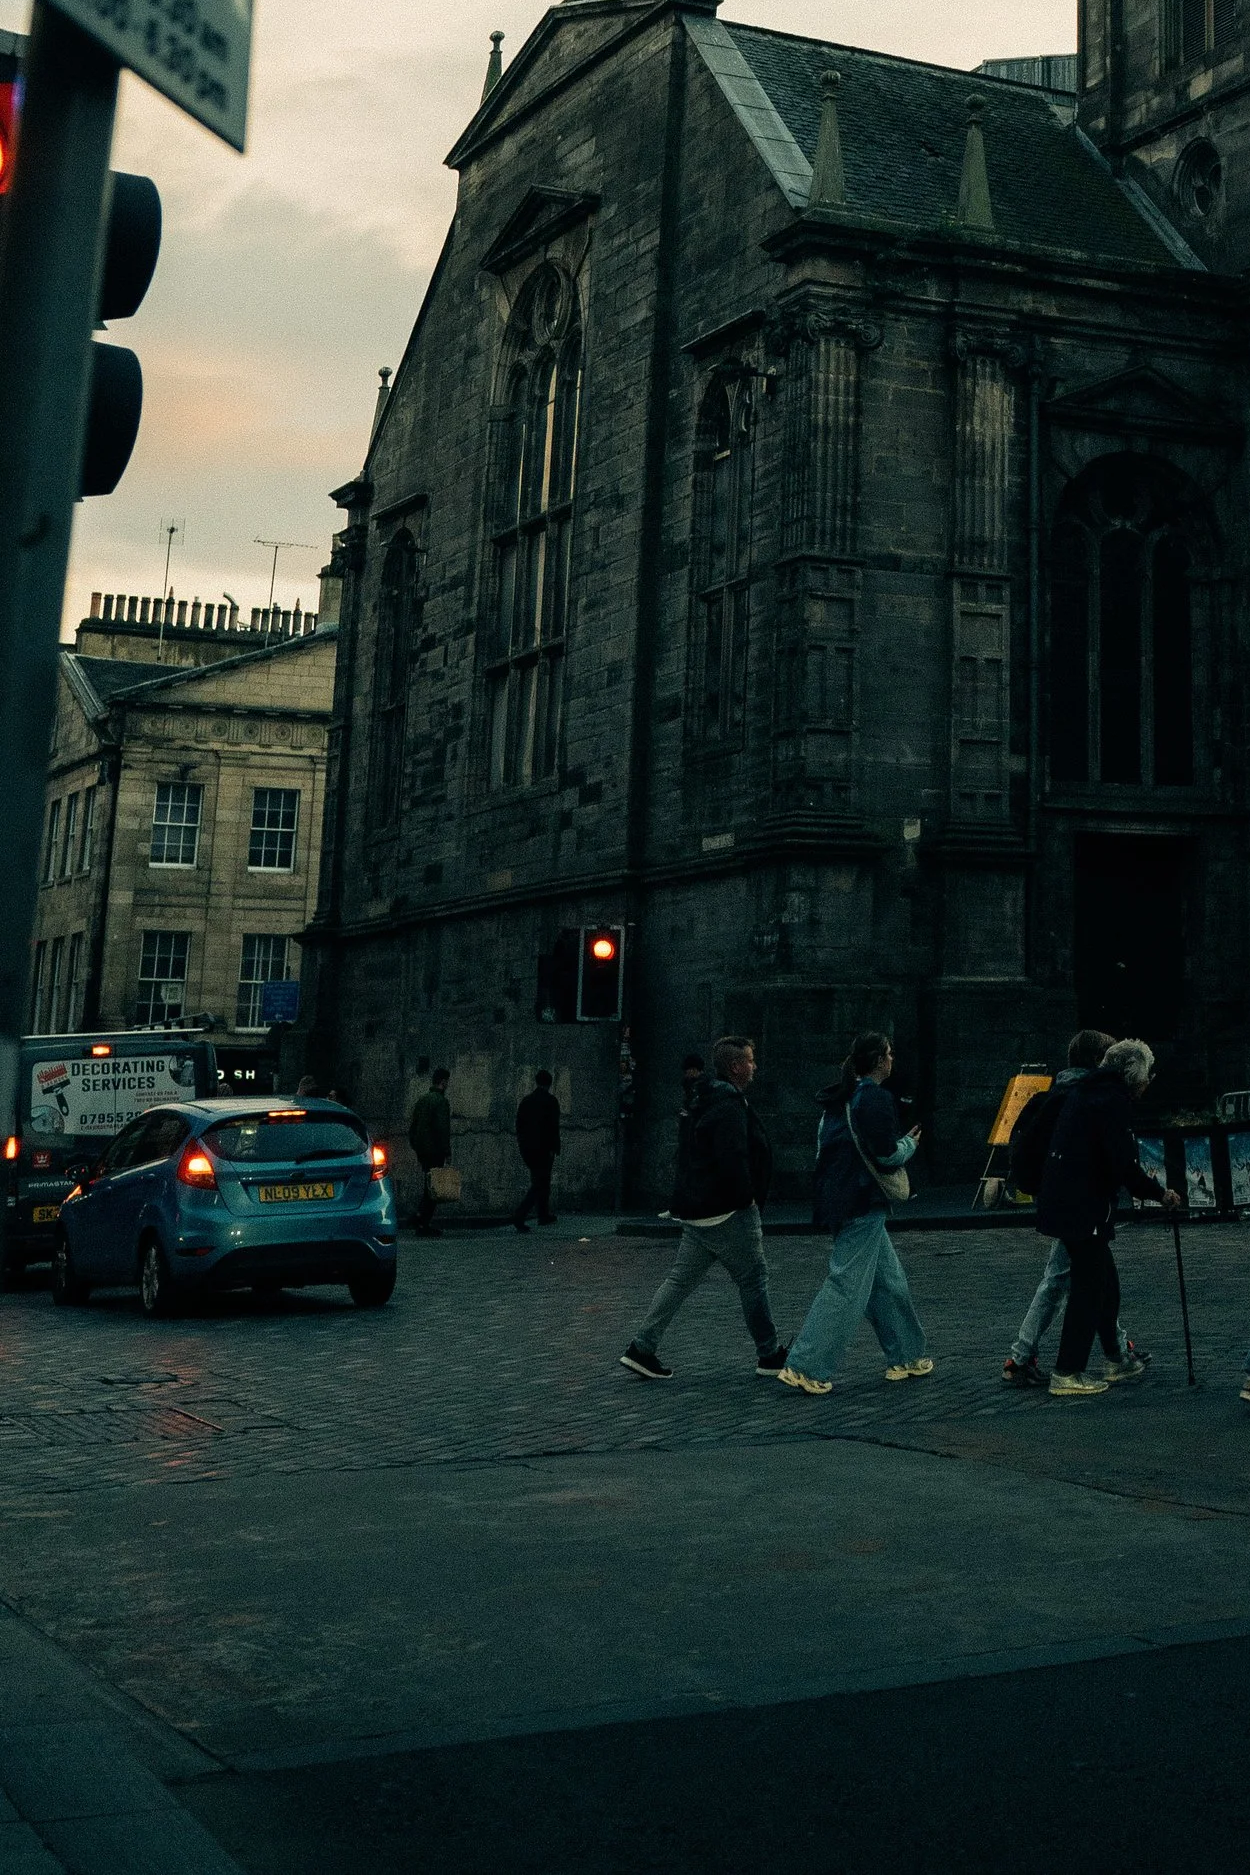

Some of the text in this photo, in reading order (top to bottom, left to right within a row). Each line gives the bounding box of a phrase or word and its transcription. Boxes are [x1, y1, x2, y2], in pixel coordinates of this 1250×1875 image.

[71, 1060, 165, 1076] DECORATING
[82, 1076, 155, 1092] SERVICES
[265, 1186, 299, 1200] NL09
